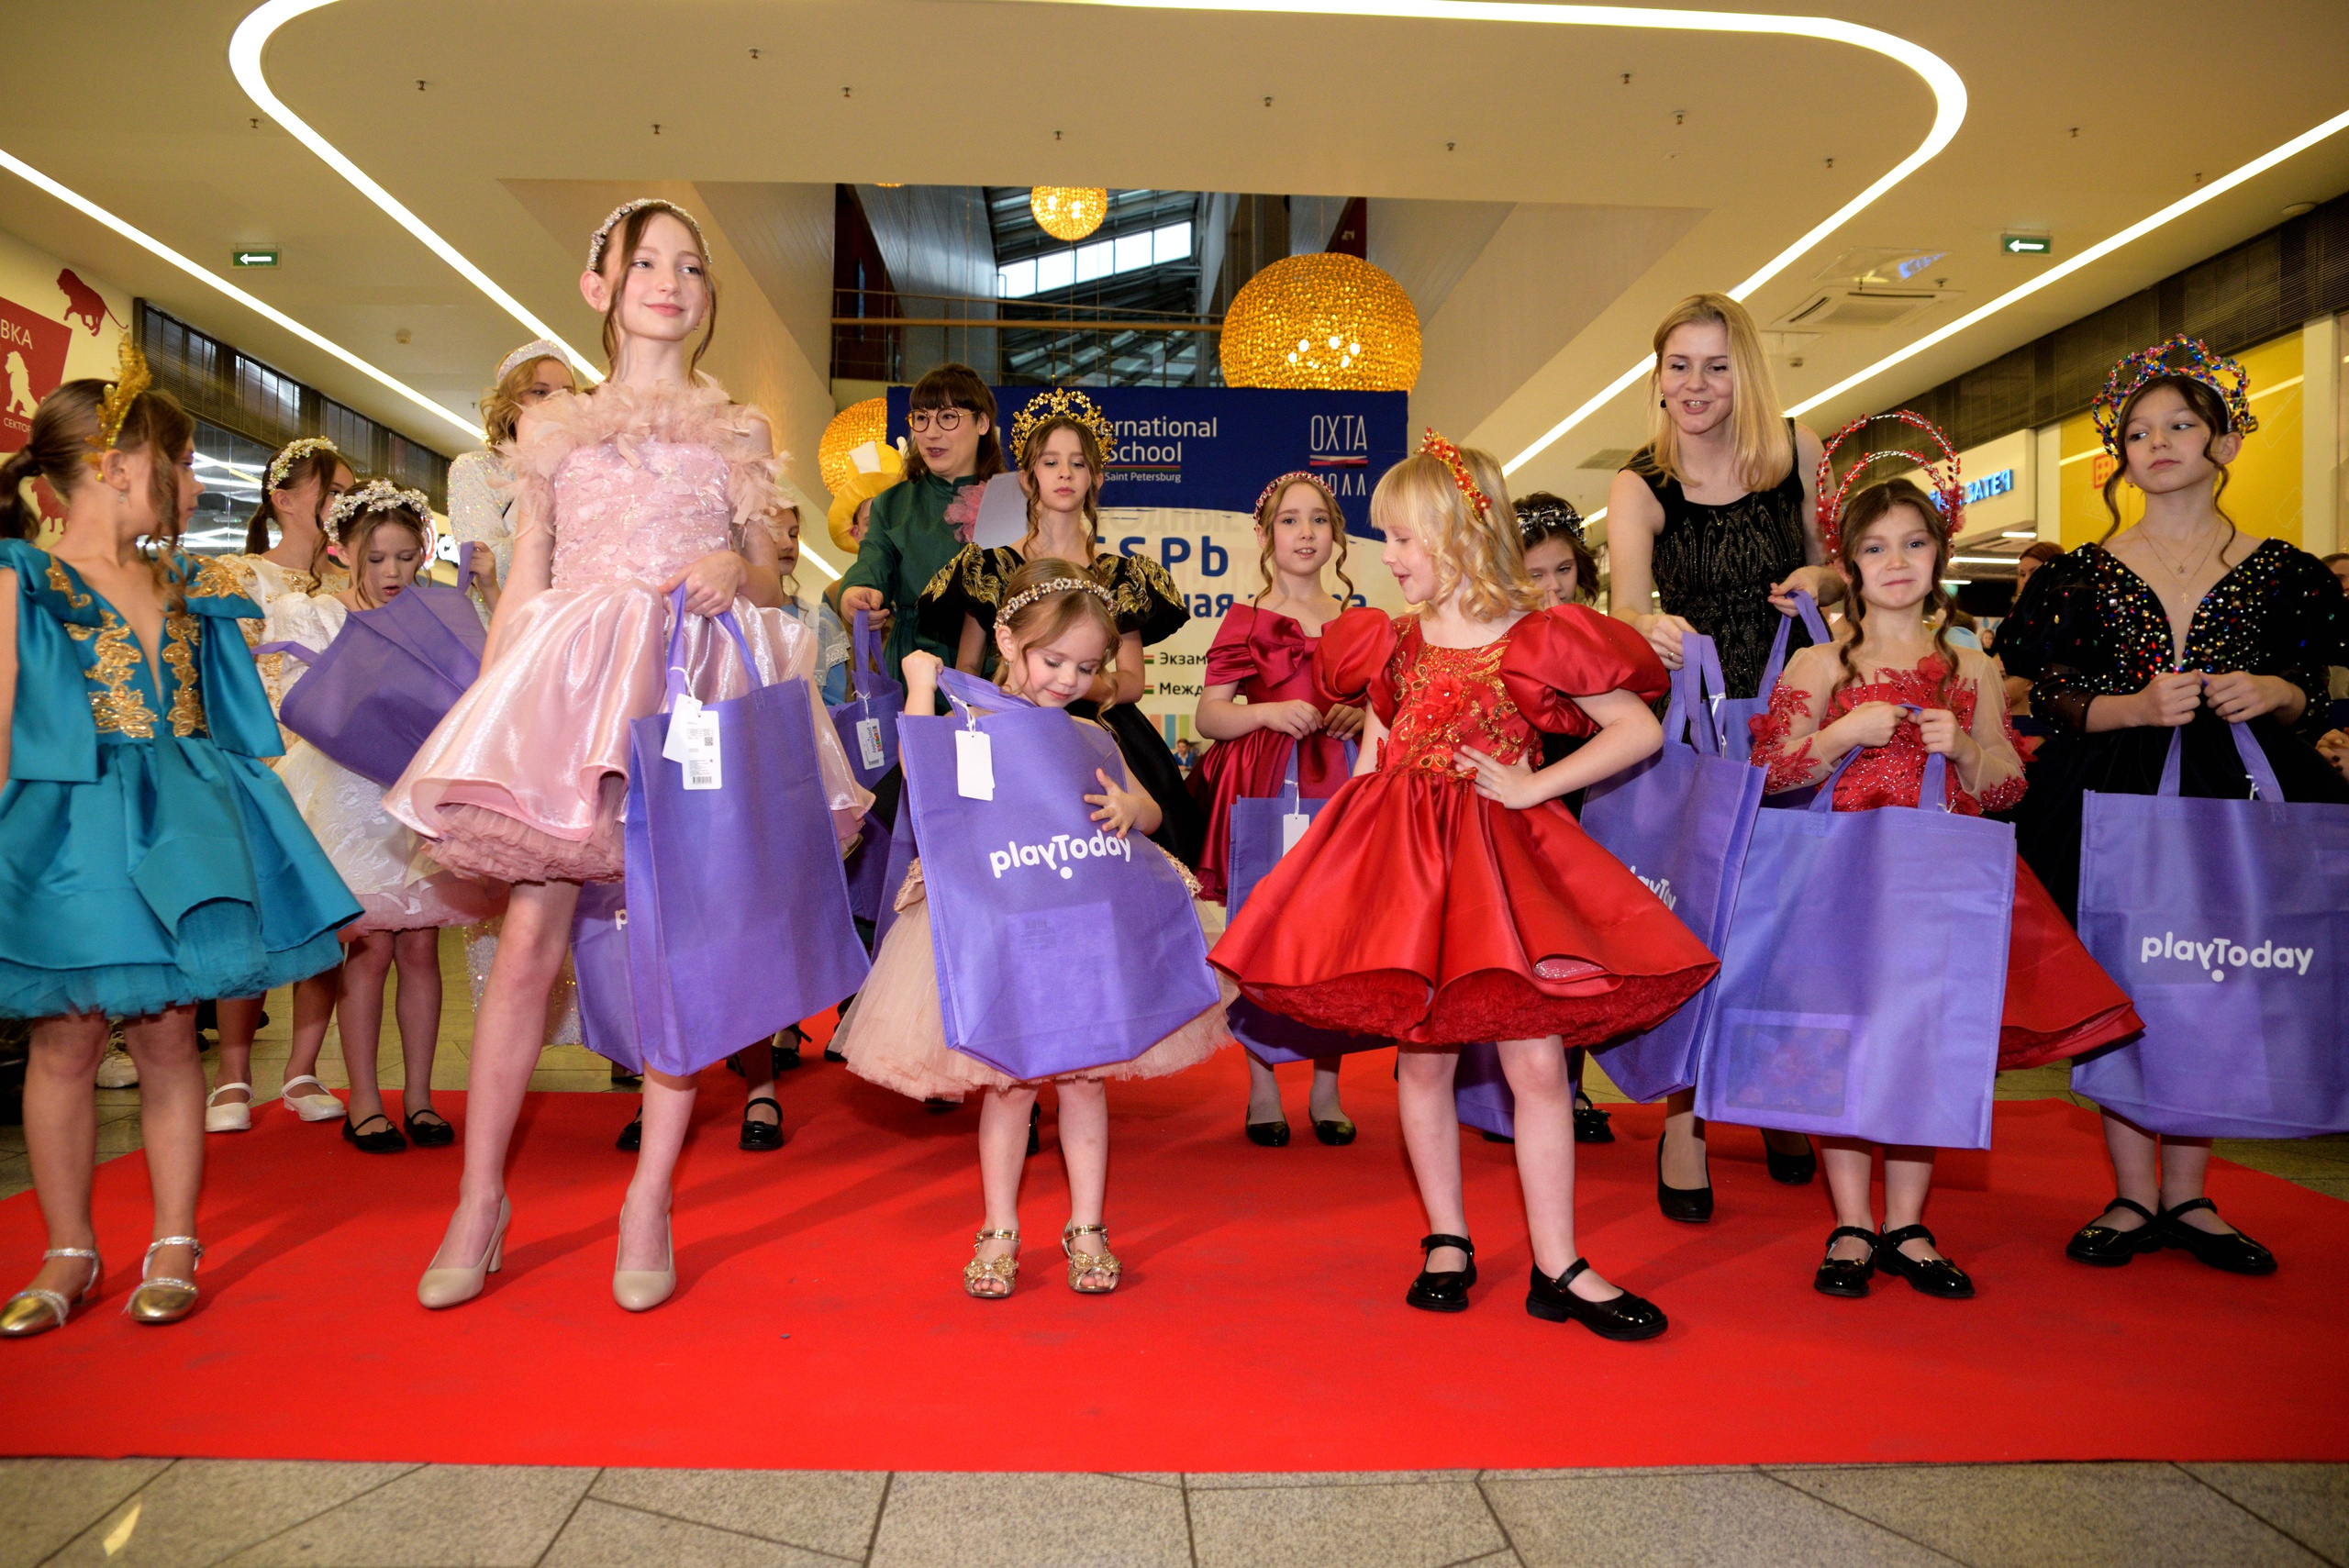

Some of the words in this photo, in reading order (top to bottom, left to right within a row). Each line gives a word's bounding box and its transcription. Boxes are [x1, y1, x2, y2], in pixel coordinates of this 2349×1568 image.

[1310, 415, 1367, 451] ОХТА
[1104, 472, 1128, 482] Saint
[1130, 472, 1182, 484] Petersburg
[1319, 473, 1366, 496] ОЛЛ
[989, 829, 1131, 879] playToday
[2141, 931, 2314, 982] playToday
